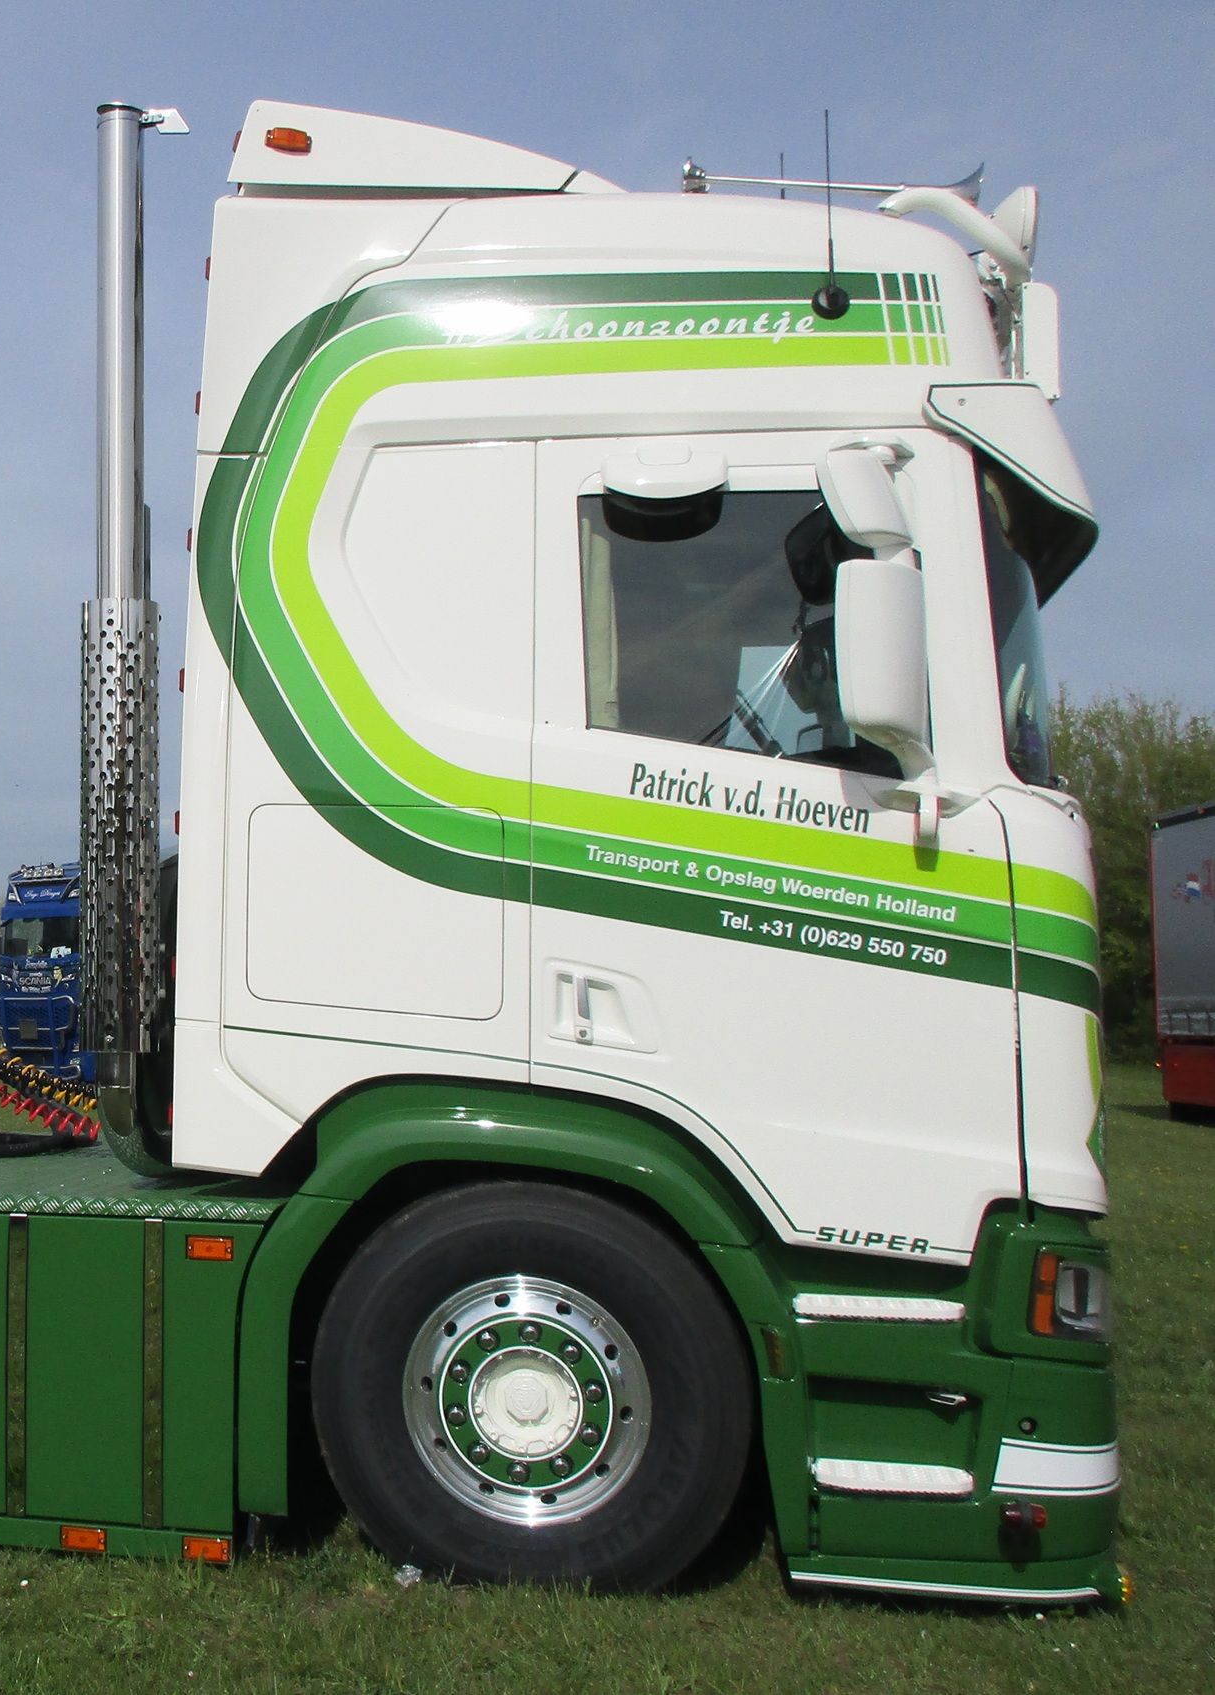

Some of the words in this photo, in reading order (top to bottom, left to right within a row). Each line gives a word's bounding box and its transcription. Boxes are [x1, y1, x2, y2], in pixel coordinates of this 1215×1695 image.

[630, 762, 713, 808] Patrick
[724, 780, 765, 818] v.d.
[775, 786, 870, 834] Hoeven
[586, 844, 680, 875] Transport
[686, 862, 698, 878] &
[705, 864, 777, 894] Opslag
[782, 877, 870, 907] Woerden
[876, 892, 956, 923] Holland
[720, 910, 753, 932] Tel.
[759, 918, 794, 939] +31
[800, 925, 863, 952] (0)629
[867, 936, 905, 958] 550
[910, 943, 947, 966] 750
[815, 1226, 929, 1253] SUPER
